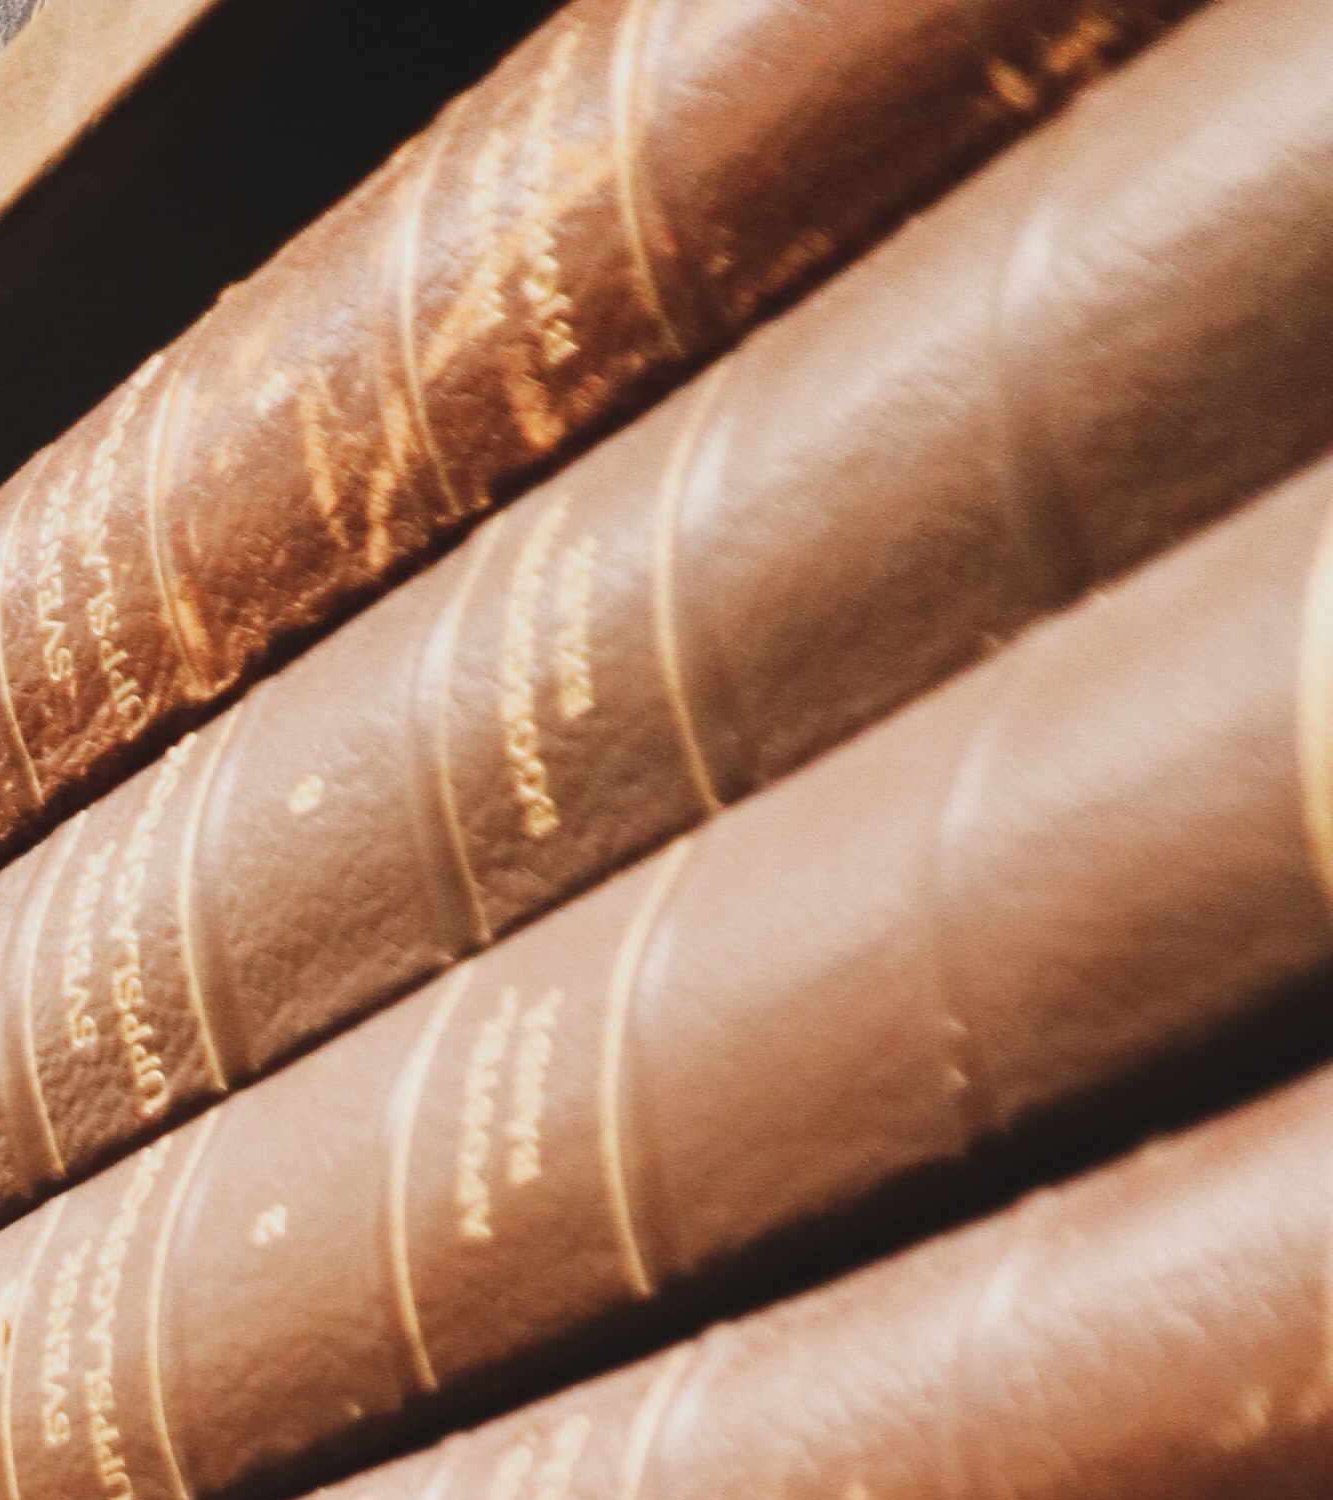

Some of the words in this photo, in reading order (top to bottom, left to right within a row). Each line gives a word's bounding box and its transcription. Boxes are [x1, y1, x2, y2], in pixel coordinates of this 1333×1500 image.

[36, 468, 79, 684] SVENSK
[63, 840, 117, 1049] SVENSK
[42, 1238, 93, 1447] SVENSK
